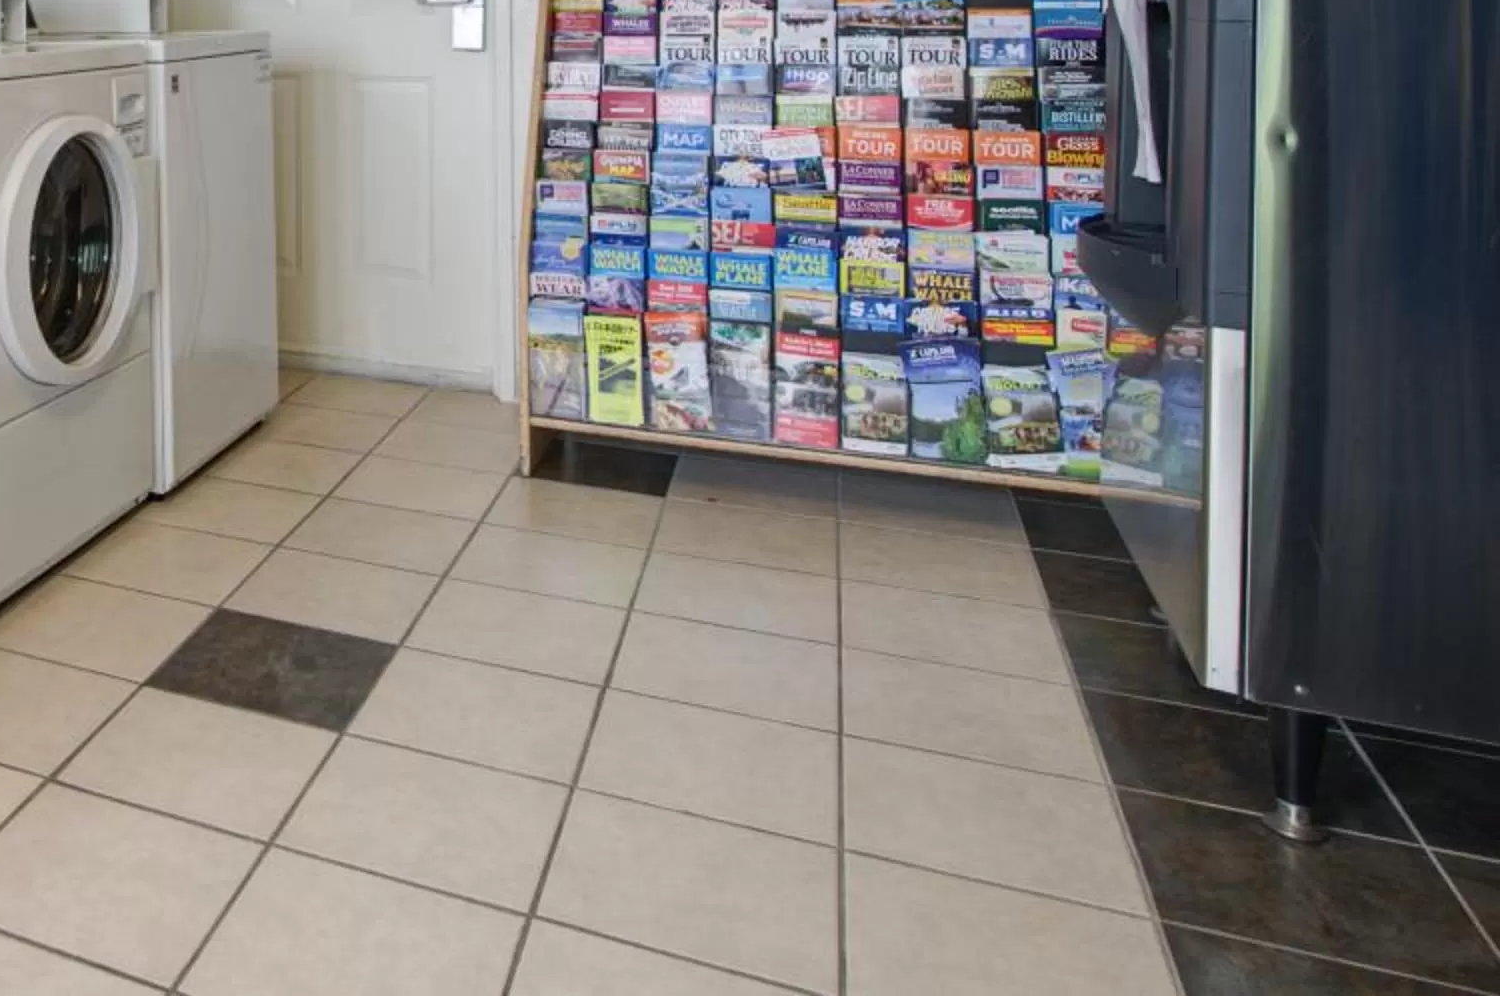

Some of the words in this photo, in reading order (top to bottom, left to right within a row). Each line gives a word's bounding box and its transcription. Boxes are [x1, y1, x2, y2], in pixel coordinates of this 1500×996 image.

[664, 47, 712, 62] TOUR
[720, 47, 769, 62] TOUR
[780, 49, 830, 63] TOUR
[844, 49, 896, 65] TOUR
[908, 49, 961, 65] TOUR
[1048, 47, 1098, 61] RIDES
[662, 131, 706, 147] MAP
[912, 138, 964, 155] TOUR
[846, 139, 897, 157] TOUR
[980, 143, 1036, 158] TOUR
[595, 258, 641, 272] WATCH
[717, 259, 765, 272] WHALE
[715, 271, 766, 284] PLANE
[915, 273, 972, 287] WHALE
[914, 288, 972, 301] WATCH
